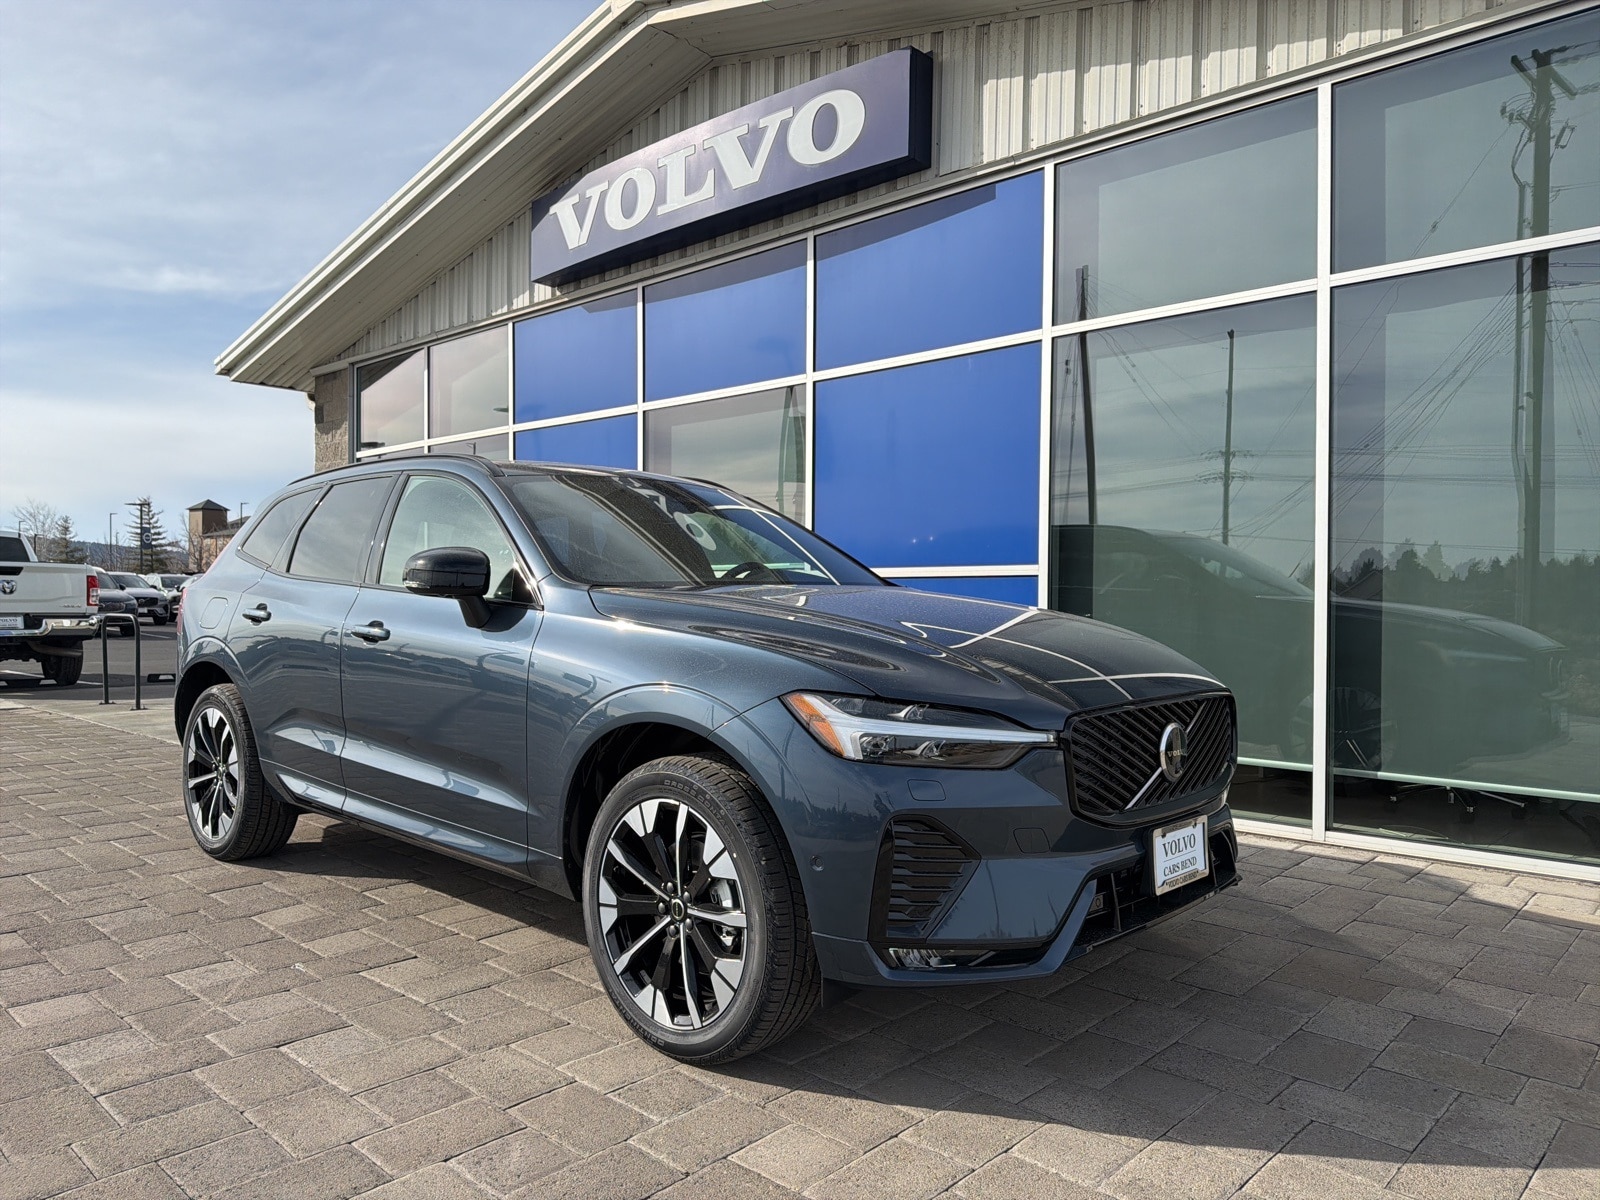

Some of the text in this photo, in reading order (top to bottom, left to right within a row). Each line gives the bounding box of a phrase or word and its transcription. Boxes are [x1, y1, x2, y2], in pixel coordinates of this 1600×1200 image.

[549, 88, 866, 251] VOLVO
[1162, 833, 1196, 858] VOLVO
[1163, 856, 1198, 877] CARS BEND
